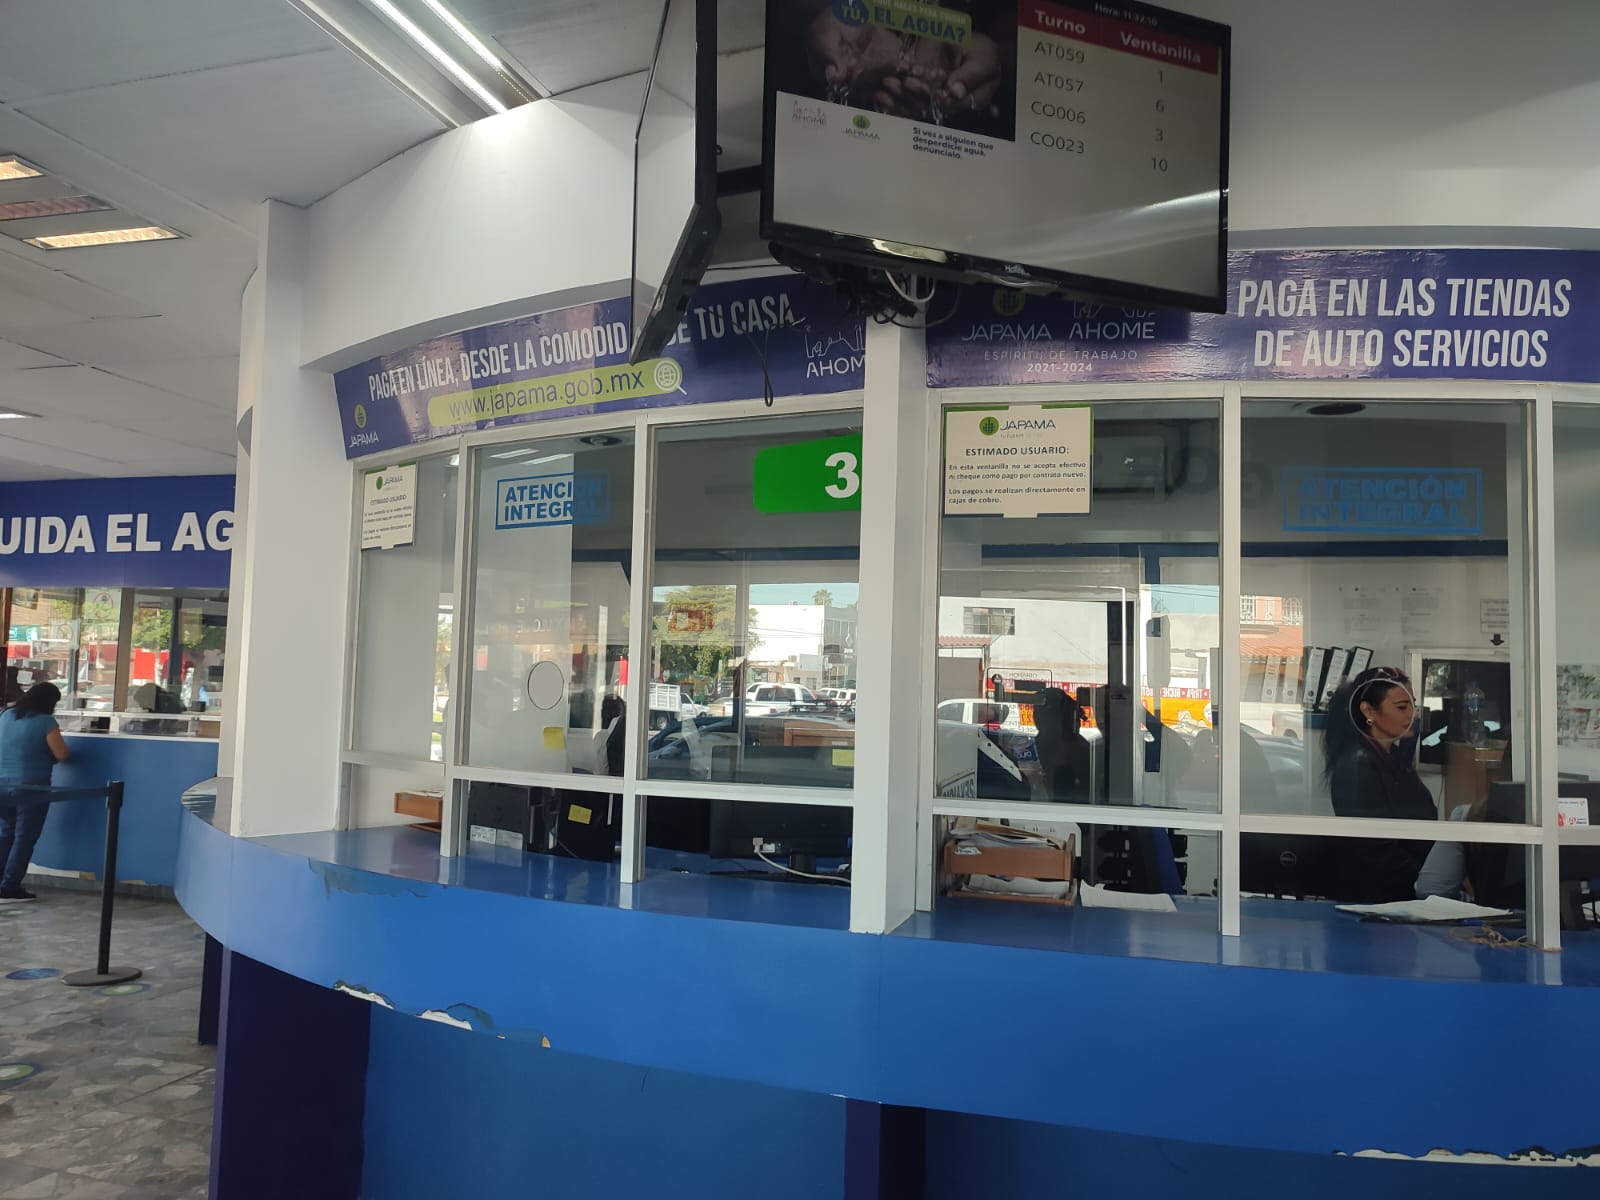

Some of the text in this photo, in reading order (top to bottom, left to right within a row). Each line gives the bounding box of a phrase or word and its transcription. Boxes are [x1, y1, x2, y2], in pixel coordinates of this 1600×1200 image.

[874, 6, 895, 26] EL
[902, 15, 966, 43] AGUA?
[1035, 9, 1201, 63] Turno Ventanilla
[1034, 41, 1164, 84] AT059 1
[1034, 71, 1165, 113] AT057 6
[1031, 101, 1164, 142] CO006 3
[912, 126, 921, 135] Si
[922, 129, 937, 138] ves
[945, 134, 976, 146] alguien
[977, 142, 994, 152] que
[912, 136, 962, 151] desperdicie
[1030, 131, 1168, 172] CO023 10
[1238, 277, 1572, 318] PAGA EN LAS TIENDAS
[961, 321, 1156, 342] JAPAMA AHOME
[368, 366, 398, 401] PAGA
[397, 365, 415, 394] EN
[416, 355, 461, 390] LÍNEA,
[460, 344, 511, 382] DESDE
[513, 338, 540, 371] LA
[541, 321, 629, 366] COMODID
[694, 303, 725, 341] TU
[730, 293, 794, 336] CASA
[1049, 350, 1066, 361] DE
[1074, 350, 1138, 361] TRABAJO
[1253, 329, 1550, 368] DE AUTO SERVICIOS
[1026, 362, 1093, 373] 2021-2024
[448, 369, 645, 419] www.japama.gob.mx
[999, 419, 1057, 431] JAPAMA
[349, 431, 380, 448] JAPAMA
[965, 445, 1070, 457] ESTIMADO USUARIO:
[824, 451, 860, 499] 3
[956, 473, 981, 481] cheque
[1033, 463, 1056, 471] acepta
[1059, 461, 1087, 469] efectivo
[505, 480, 585, 503] ATENCI
[948, 487, 961, 495] Los
[1024, 486, 1075, 494] directamente
[1298, 475, 1466, 501] ATENCIÓN
[504, 500, 585, 522] INTEGR
[948, 497, 967, 505] cajas
[978, 496, 1002, 504] cobro.
[1298, 502, 1463, 523] INTEGRAL
[0, 515, 96, 555] UIDA
[106, 512, 161, 553] EL
